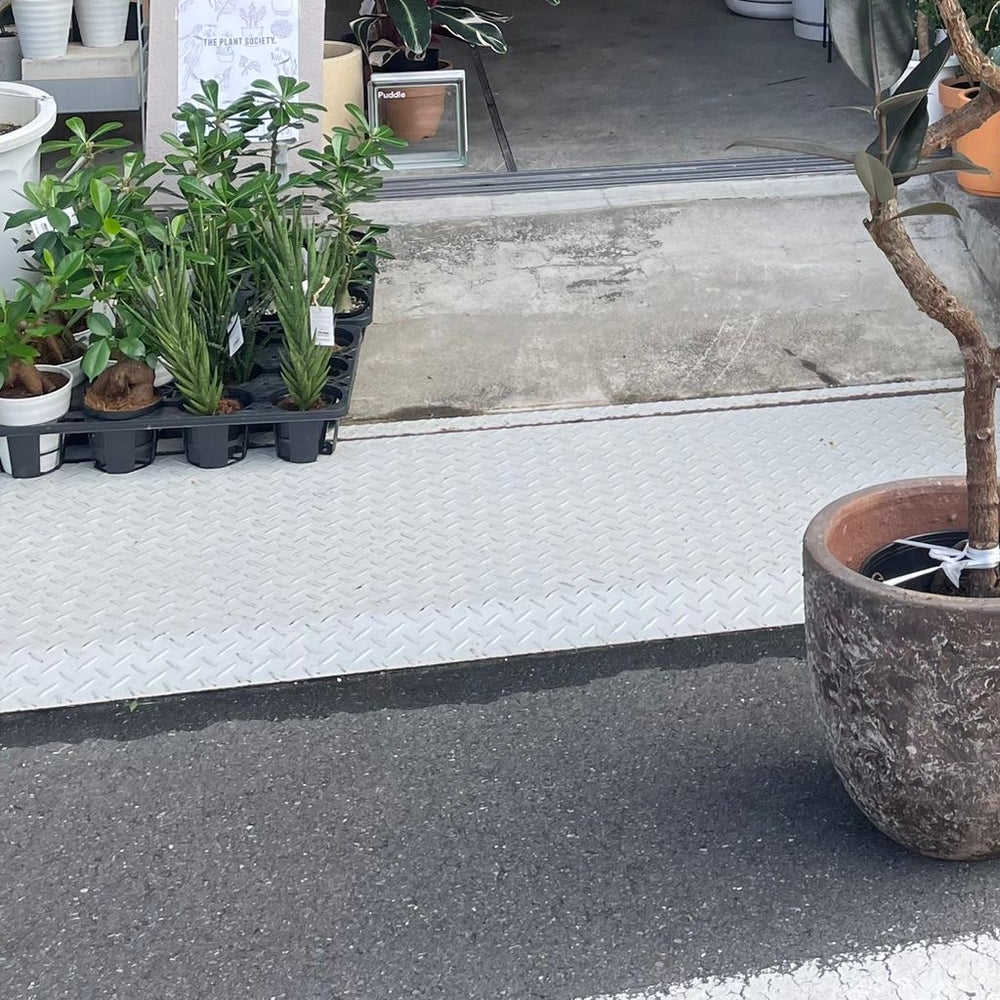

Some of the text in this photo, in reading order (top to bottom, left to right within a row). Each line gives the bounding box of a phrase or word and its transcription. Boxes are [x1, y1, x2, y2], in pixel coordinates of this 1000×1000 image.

[203, 38, 217, 47] THE
[219, 37, 243, 46] PLANT
[377, 91, 406, 99] Puddle
